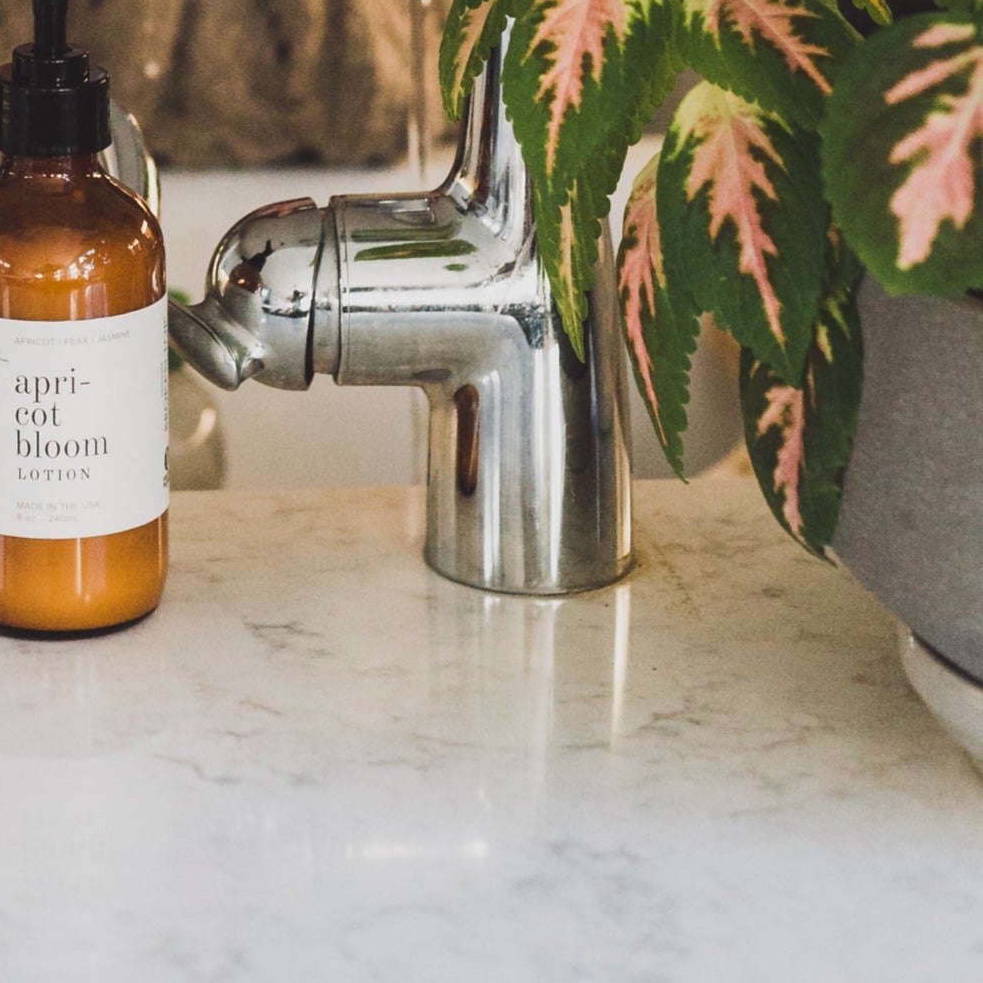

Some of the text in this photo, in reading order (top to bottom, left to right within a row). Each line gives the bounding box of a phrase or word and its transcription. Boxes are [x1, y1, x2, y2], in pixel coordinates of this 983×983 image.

[14, 337, 54, 347] APRICOT
[64, 336, 89, 346] PEAR
[14, 368, 91, 403] apri-
[15, 403, 62, 427] cot
[17, 430, 109, 459] bloom
[17, 468, 91, 481] LOTION
